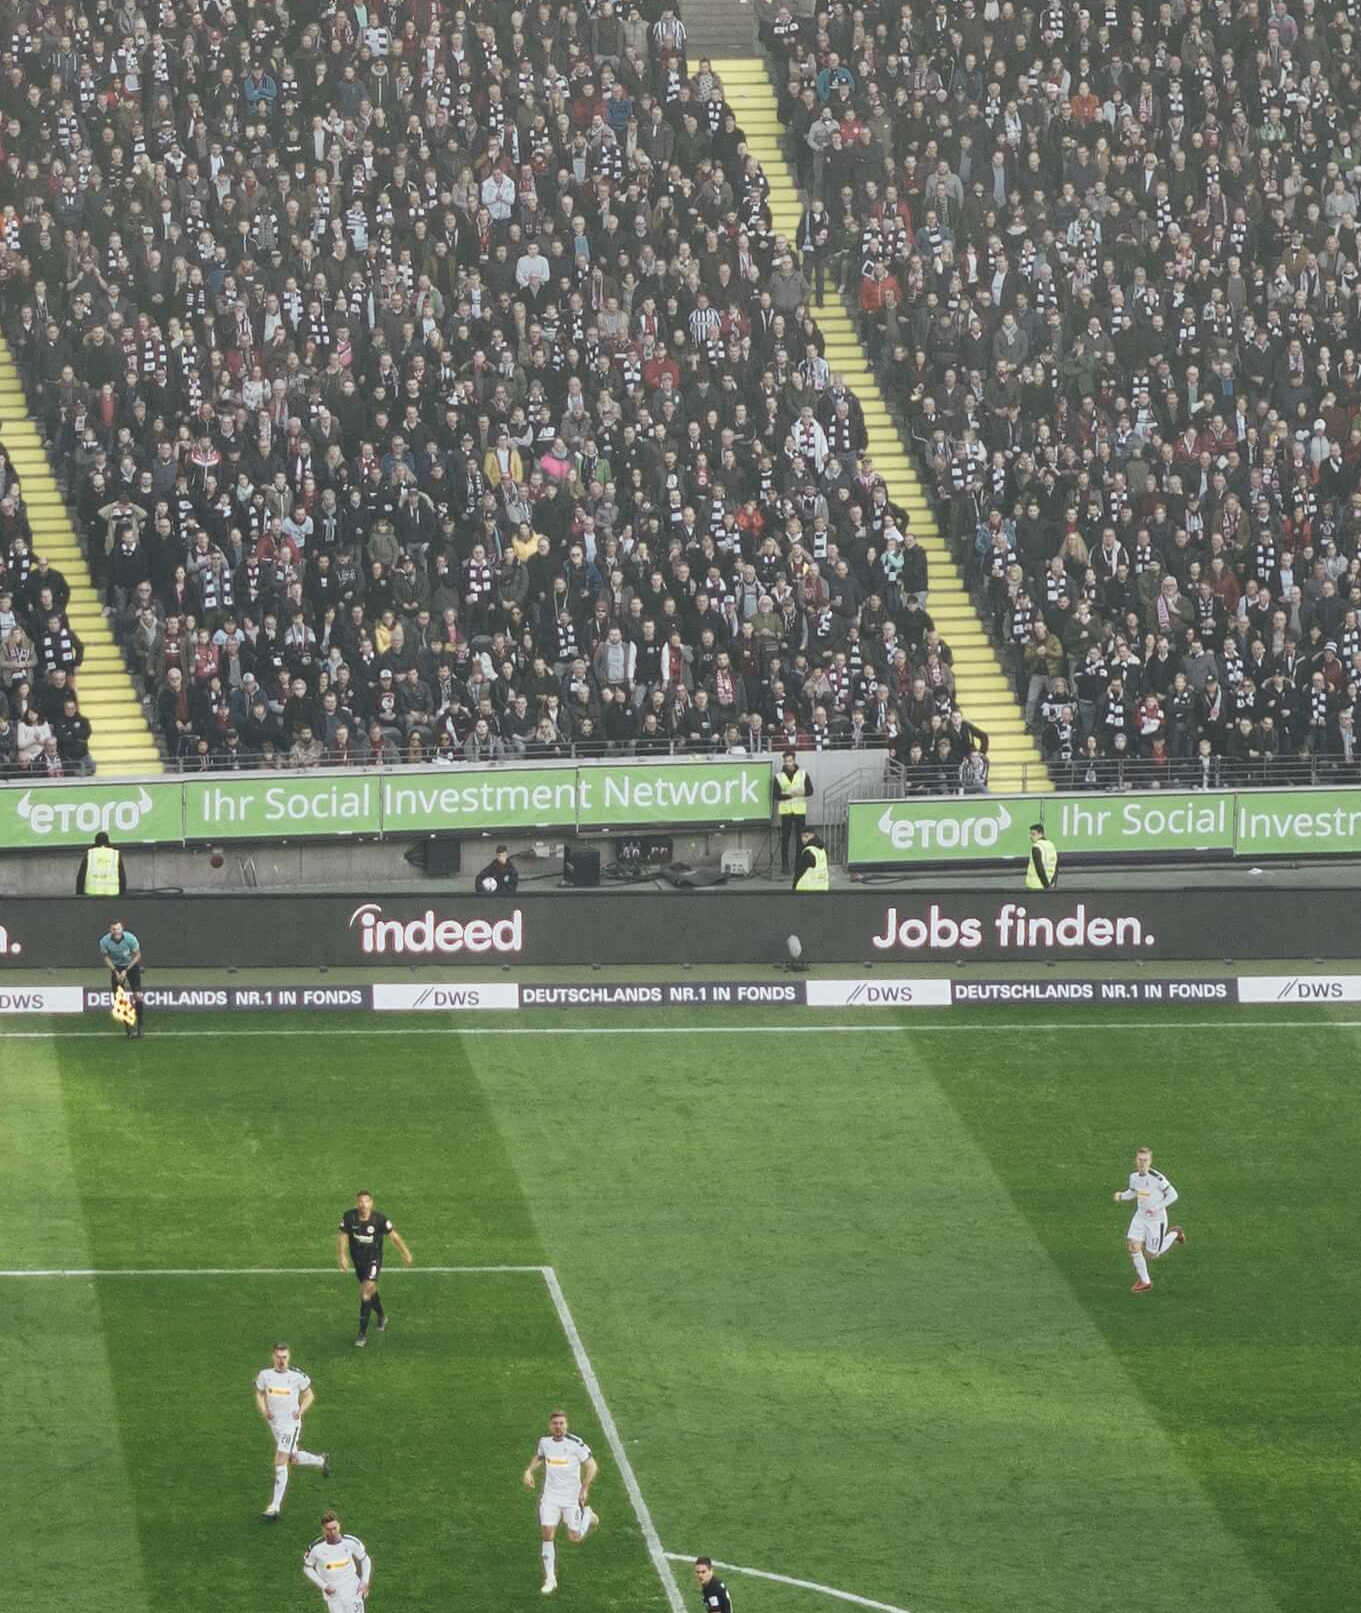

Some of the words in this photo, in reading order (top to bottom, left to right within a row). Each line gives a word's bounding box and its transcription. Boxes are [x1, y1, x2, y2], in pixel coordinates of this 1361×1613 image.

[203, 788, 253, 822] Ihr
[265, 781, 370, 820] Social
[385, 775, 592, 816] Investment
[605, 771, 758, 807] Network
[1061, 804, 1111, 837] Ihr
[1122, 801, 1225, 836] Social
[349, 903, 523, 952] indeed
[872, 904, 982, 948] Jobs
[995, 903, 1155, 948] finden.
[235, 990, 273, 1006] NR.1
[278, 990, 297, 1006] IN
[303, 988, 362, 1005] FONDS
[433, 990, 480, 1006] DWS
[523, 987, 662, 1004] DEUTSCHLANDS
[670, 986, 707, 1003] NR.1
[713, 986, 731, 1002] IN
[737, 986, 796, 1002] FONDS
[867, 987, 913, 1002] DWS
[955, 984, 1093, 1000] DEUTSCHLANDS
[1101, 984, 1139, 999] NR.1
[1144, 984, 1162, 998] IN
[1168, 983, 1227, 998] FONDS
[1297, 983, 1343, 998] DWS
